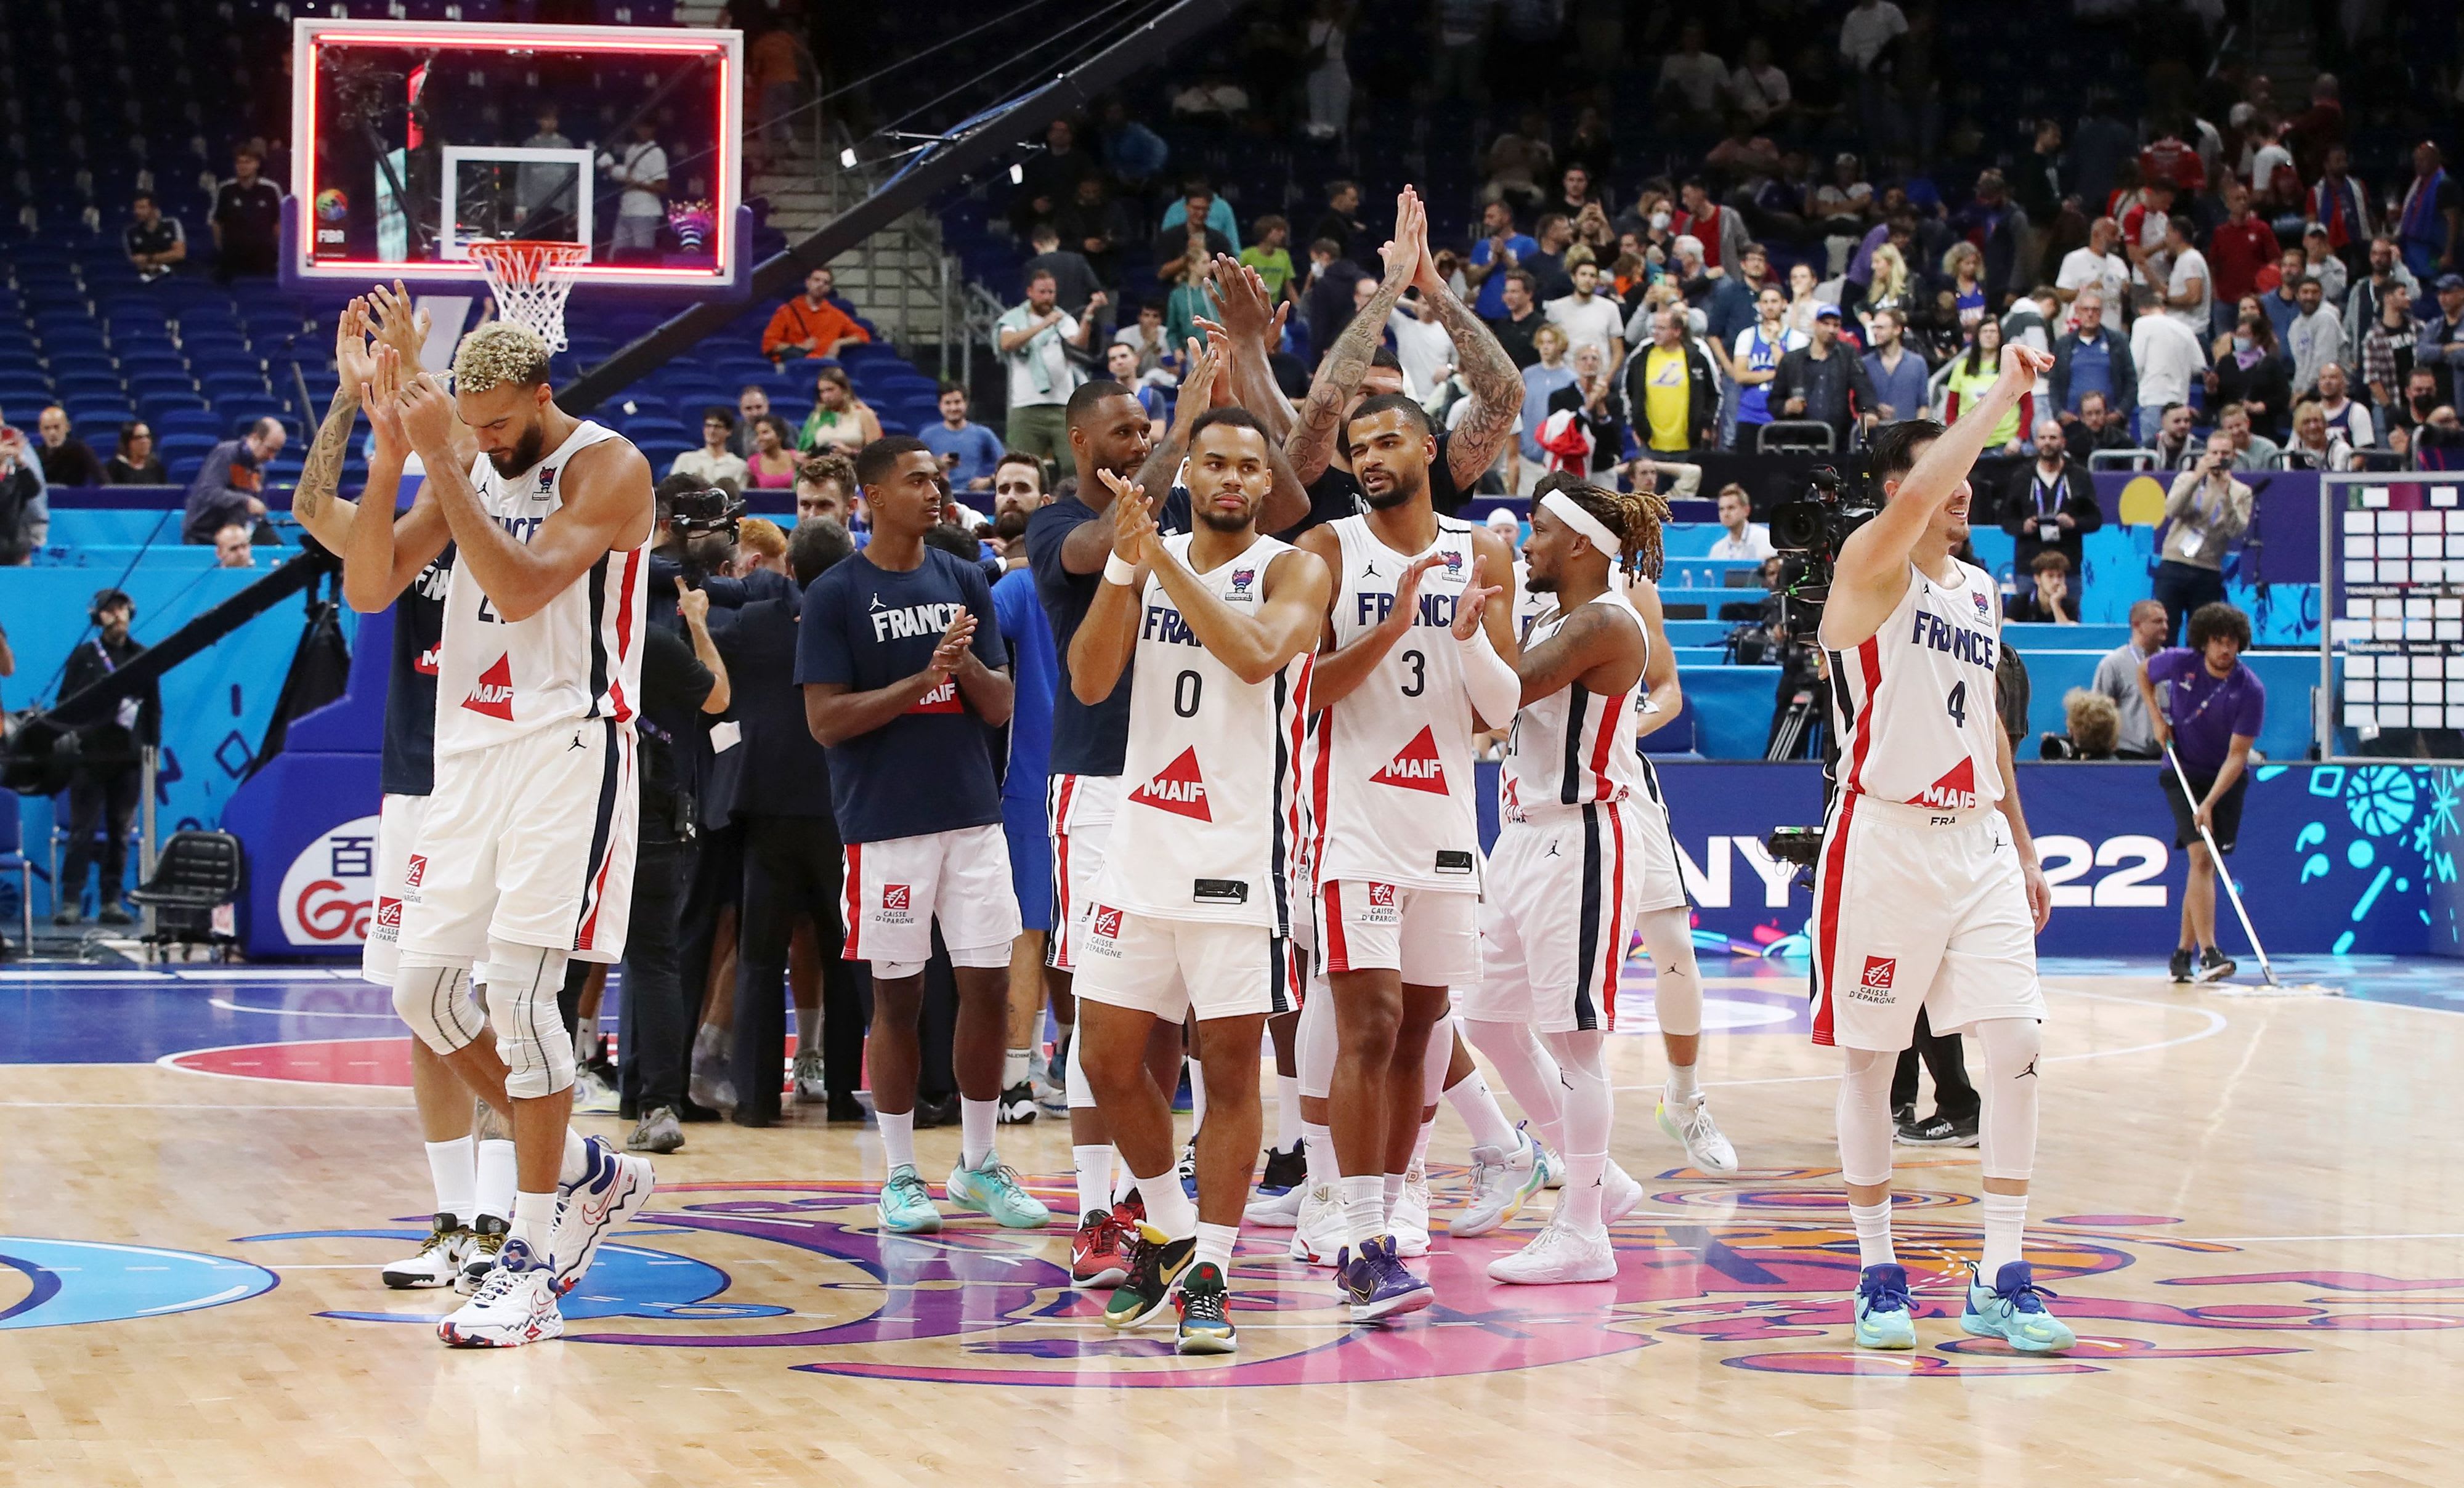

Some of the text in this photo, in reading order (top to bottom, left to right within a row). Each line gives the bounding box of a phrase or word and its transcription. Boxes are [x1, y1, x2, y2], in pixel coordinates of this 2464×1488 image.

[1357, 592, 1459, 628] FRNC
[1142, 605, 1202, 648] FRA
[1401, 650, 1425, 697] 3
[470, 683, 514, 703] MAIF
[919, 683, 955, 705] AIF
[1174, 669, 1202, 718] 0
[1947, 680, 1966, 728] 4
[1384, 758, 1442, 778] MAIF
[1143, 779, 1206, 803] MAIF
[1931, 817, 1956, 826] FRA
[2032, 835, 2168, 907] 22
[1371, 907, 1393, 915] CAISSE
[1091, 936, 1114, 948] CAISSE
[1849, 990, 1896, 1005] D'EPARGNE
[1860, 987, 1889, 997] CAISSE
